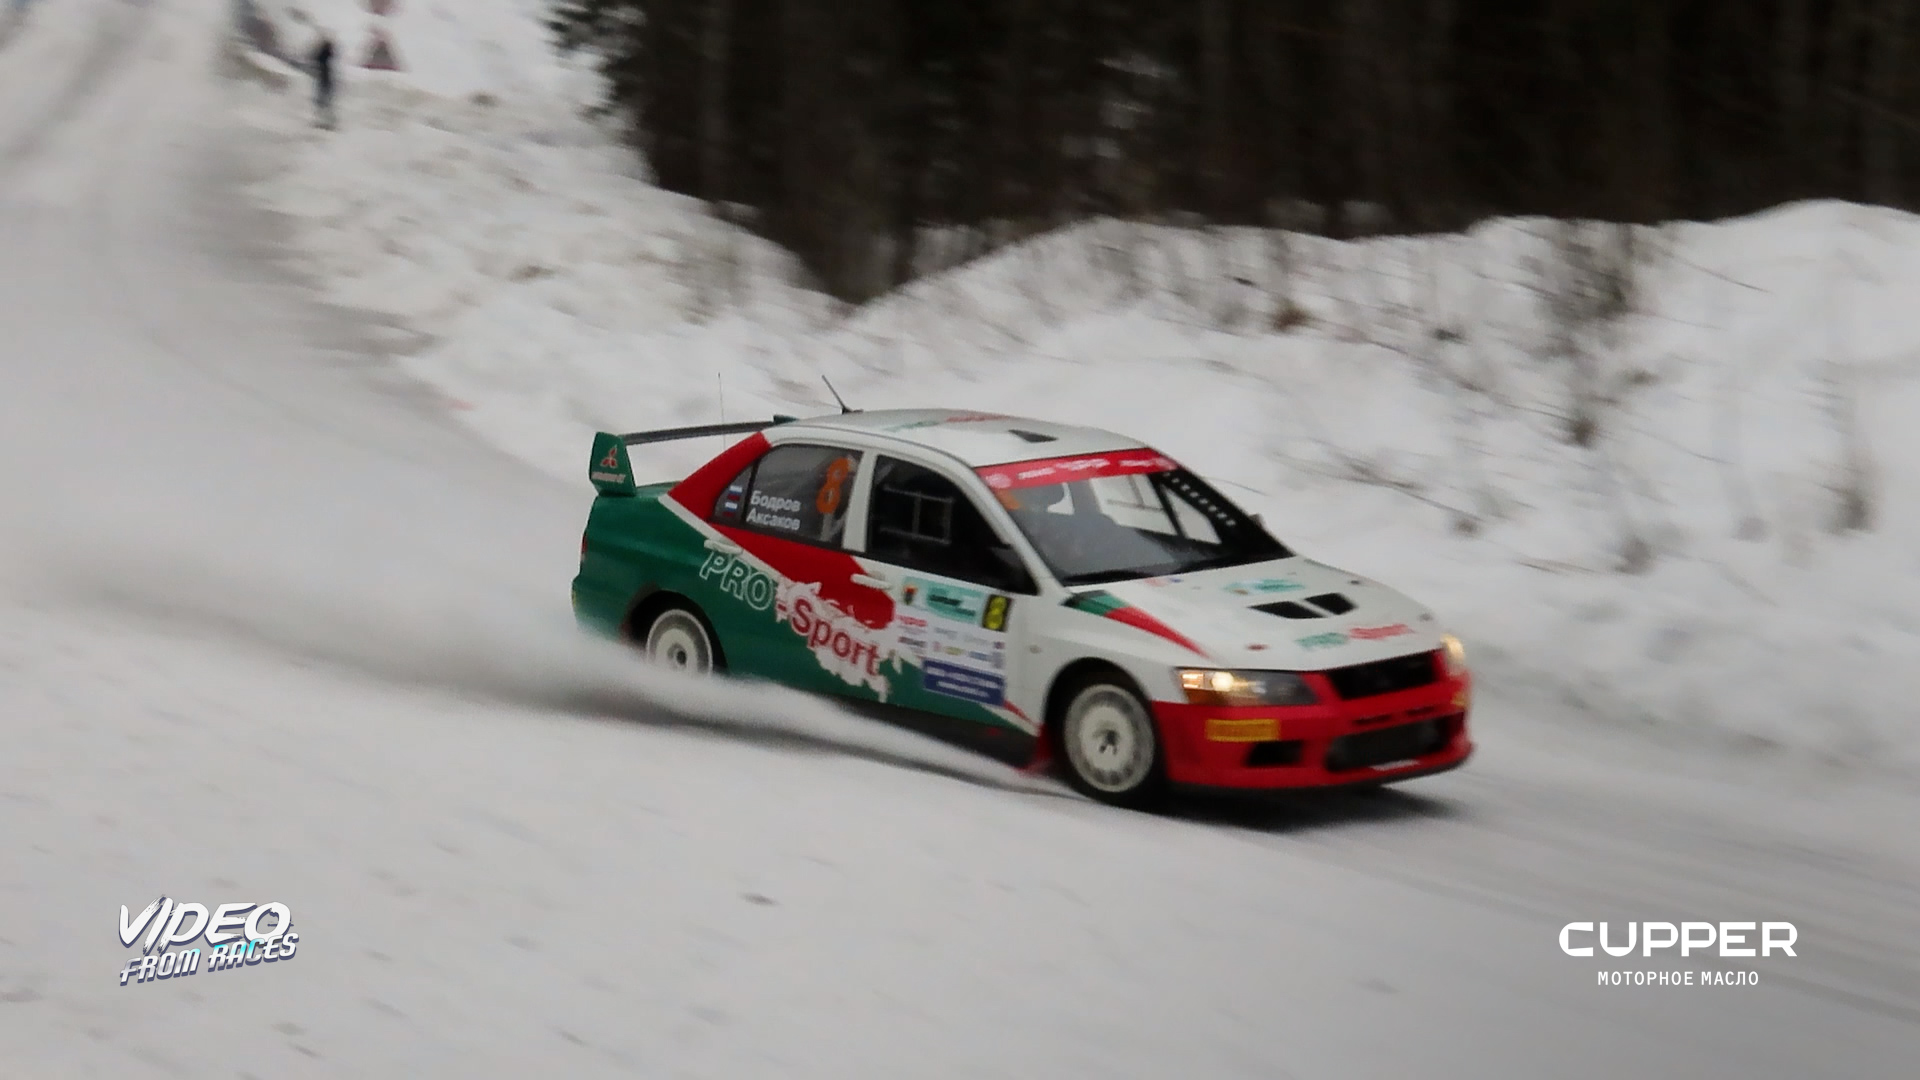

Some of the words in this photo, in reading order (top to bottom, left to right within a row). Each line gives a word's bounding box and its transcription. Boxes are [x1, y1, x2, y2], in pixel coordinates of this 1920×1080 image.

[750, 490, 801, 512] Бодров
[816, 457, 850, 514] 8
[746, 508, 801, 530] Аксаков
[699, 550, 774, 611] PRO
[983, 595, 1008, 632] 8
